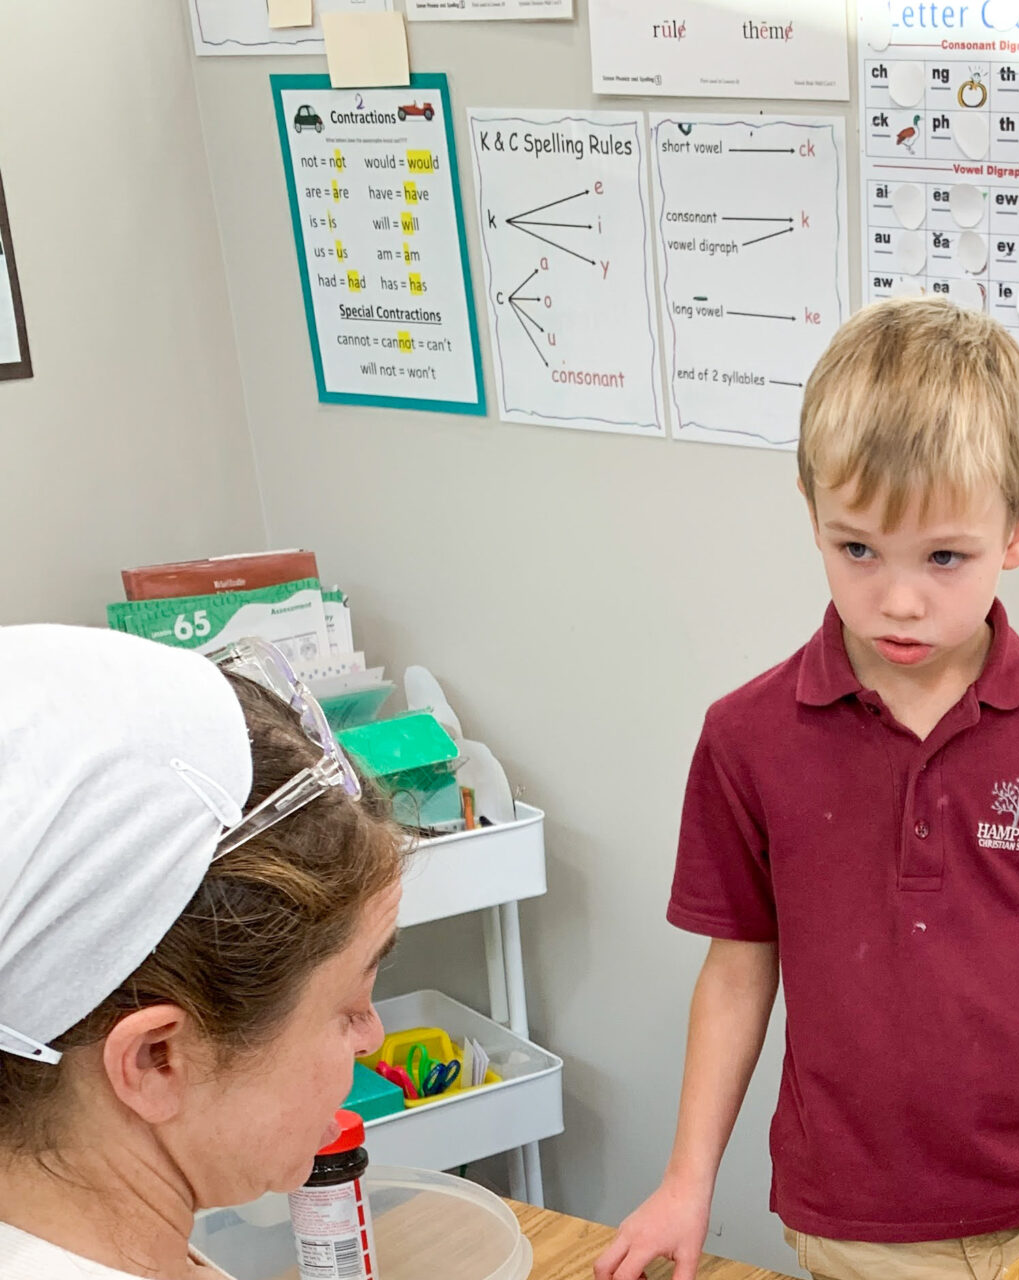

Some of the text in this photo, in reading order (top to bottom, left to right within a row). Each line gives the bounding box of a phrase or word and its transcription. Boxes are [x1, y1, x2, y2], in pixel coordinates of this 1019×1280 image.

[941, 40, 996, 51] Consonant
[872, 64, 887, 79] ch
[932, 67, 949, 83] ng
[1000, 67, 1016, 81] th
[355, 93, 365, 110] 2
[330, 110, 396, 125] Contractions
[872, 113, 889, 128] ck
[932, 117, 949, 131] ph
[1000, 117, 1015, 131] th
[480, 131, 632, 160] K & C Spelling Rules
[662, 139, 816, 157] short vowel ck
[301, 156, 347, 168] not not
[364, 155, 439, 170] would would
[953, 164, 983, 175] Vowel
[305, 187, 349, 199] are are
[368, 186, 429, 201] have have
[594, 180, 604, 195] e
[996, 193, 1018, 206] ew
[309, 215, 337, 229] is is
[372, 216, 420, 231] will will
[488, 209, 496, 229] k
[666, 210, 810, 228] consonant k
[874, 233, 891, 244] au
[314, 247, 348, 259] us us
[668, 238, 738, 256] vowel digraph
[997, 240, 1014, 255] ey
[377, 249, 421, 261] am am
[540, 257, 549, 270] a
[600, 260, 610, 280] y
[318, 273, 366, 289] had had
[381, 276, 428, 292] has has
[874, 277, 893, 288] aw
[544, 295, 552, 308] o
[339, 304, 442, 322] Special Contractions
[672, 301, 821, 324] long vowel ke
[337, 335, 452, 352] cannot cannot can't
[548, 333, 556, 346] u
[360, 363, 436, 380] will not won't
[552, 369, 624, 388] consonant
[677, 368, 765, 387] end of 2 syllables
[174, 610, 211, 640] 65
[978, 838, 1016, 851] CHRISTIAN
